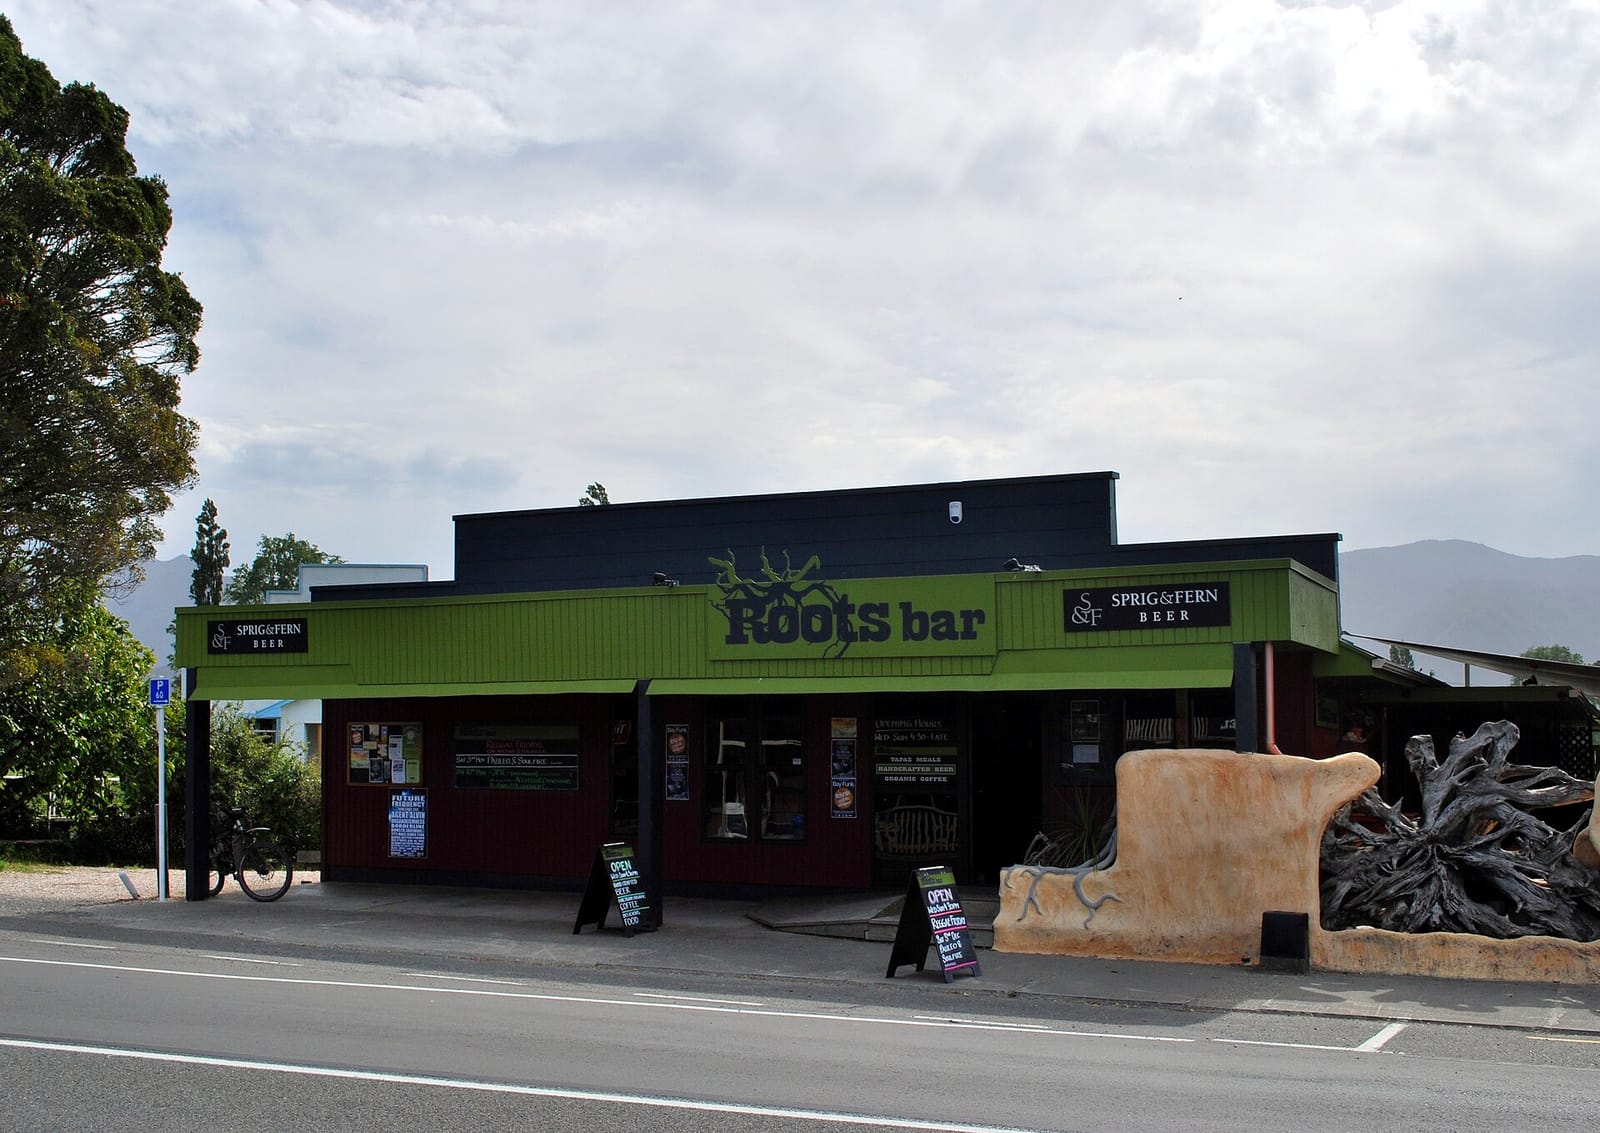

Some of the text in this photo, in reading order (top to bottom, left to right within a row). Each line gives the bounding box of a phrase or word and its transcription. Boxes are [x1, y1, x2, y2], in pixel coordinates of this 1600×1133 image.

[1111, 589, 1219, 608] SPRIG&FERN
[725, 594, 986, 645] Roots bar
[1139, 609, 1190, 623] BEER
[236, 623, 302, 636] SPRIG&FERN
[253, 639, 285, 649] BEER
[156, 680, 165, 690] P
[610, 860, 632, 872] OPEN
[927, 888, 954, 904] OPEN
[619, 900, 640, 911] COFFEE
[623, 917, 640, 927] FOOD
